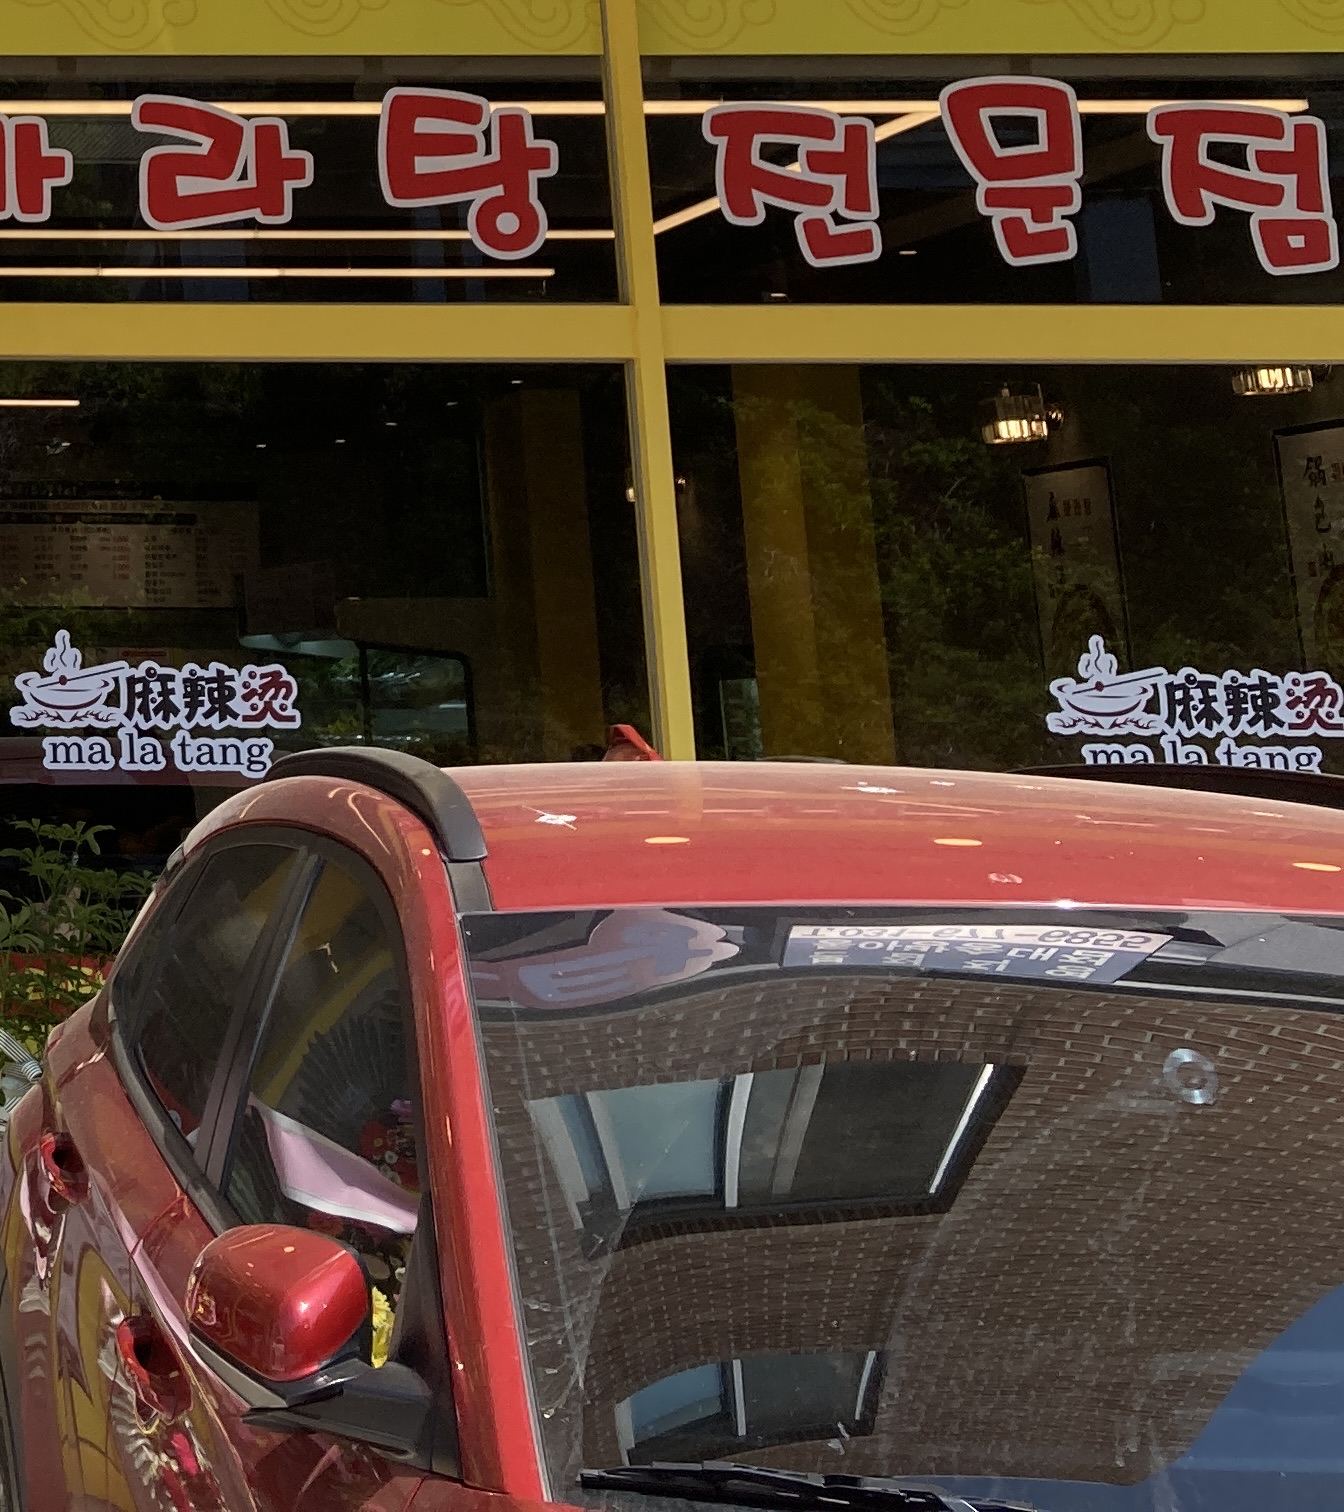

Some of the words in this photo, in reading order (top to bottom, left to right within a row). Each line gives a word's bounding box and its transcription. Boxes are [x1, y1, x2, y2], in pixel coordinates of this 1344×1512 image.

[702, 75, 1340, 276] 전문점
[48, 740, 110, 764] ma
[124, 733, 162, 765] la
[176, 735, 269, 773] tang
[1089, 749, 1151, 765] ma
[1165, 741, 1204, 766] la
[1222, 742, 1317, 772] tang
